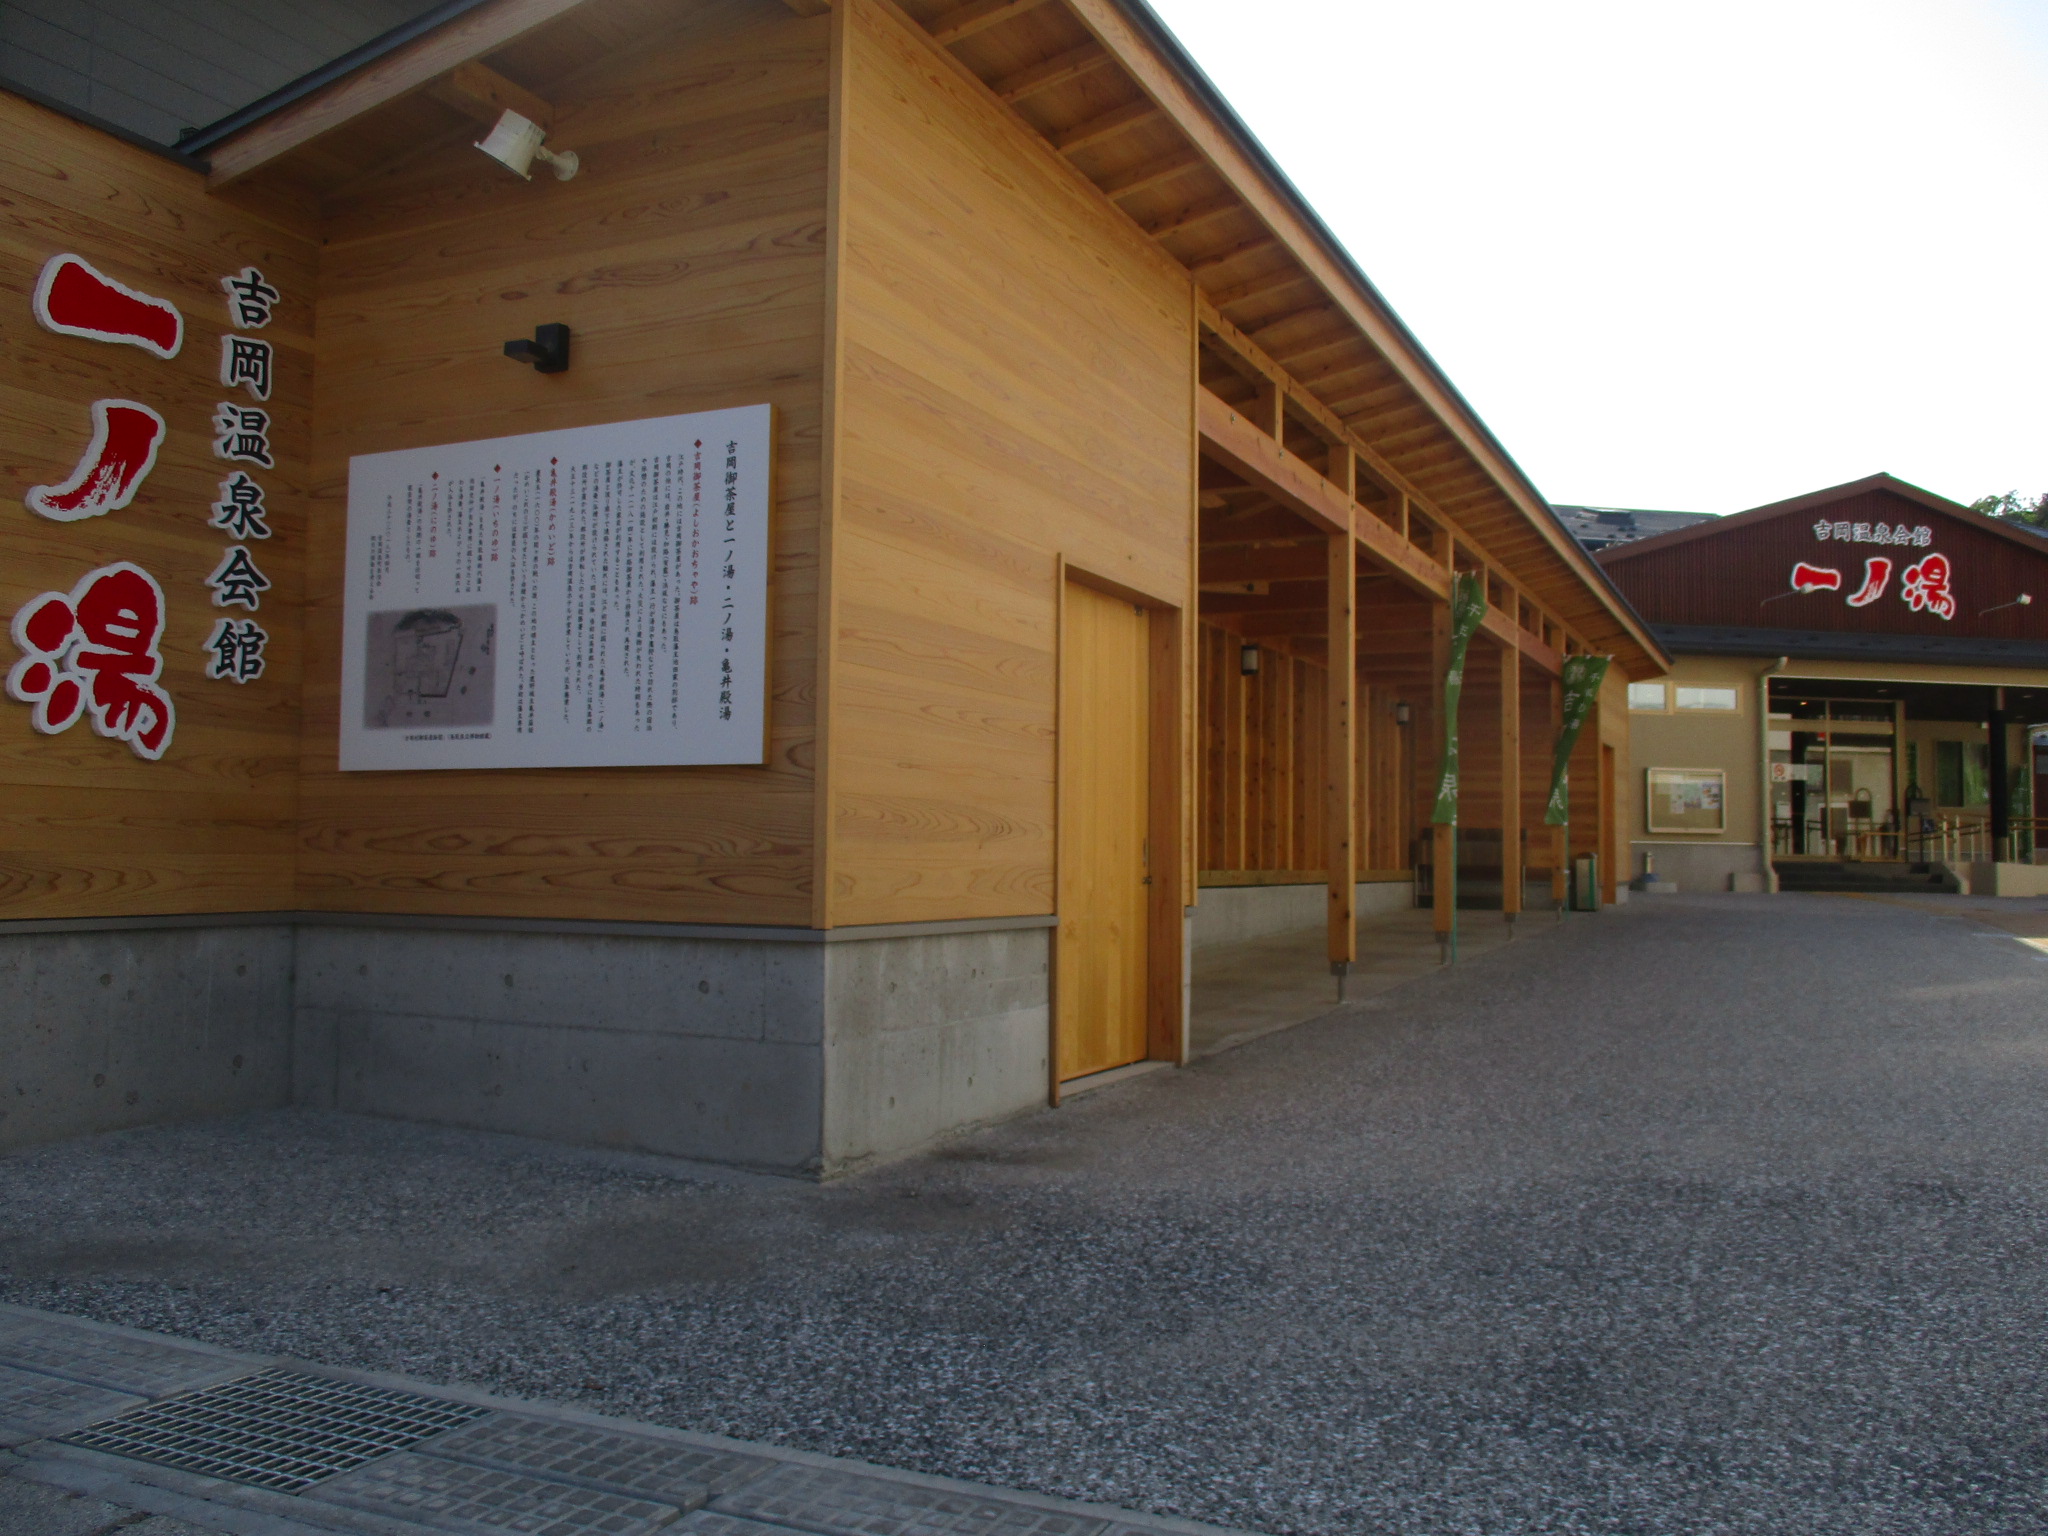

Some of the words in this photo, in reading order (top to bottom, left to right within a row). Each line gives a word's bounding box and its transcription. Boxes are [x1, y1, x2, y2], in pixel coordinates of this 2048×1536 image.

[8, 253, 183, 760] 一ノ湯
[204, 267, 279, 685] 吉岡温泉会館
[1791, 553, 1955, 620] 一ノ湯
[1813, 519, 1932, 547] 吉岡温泉会館
